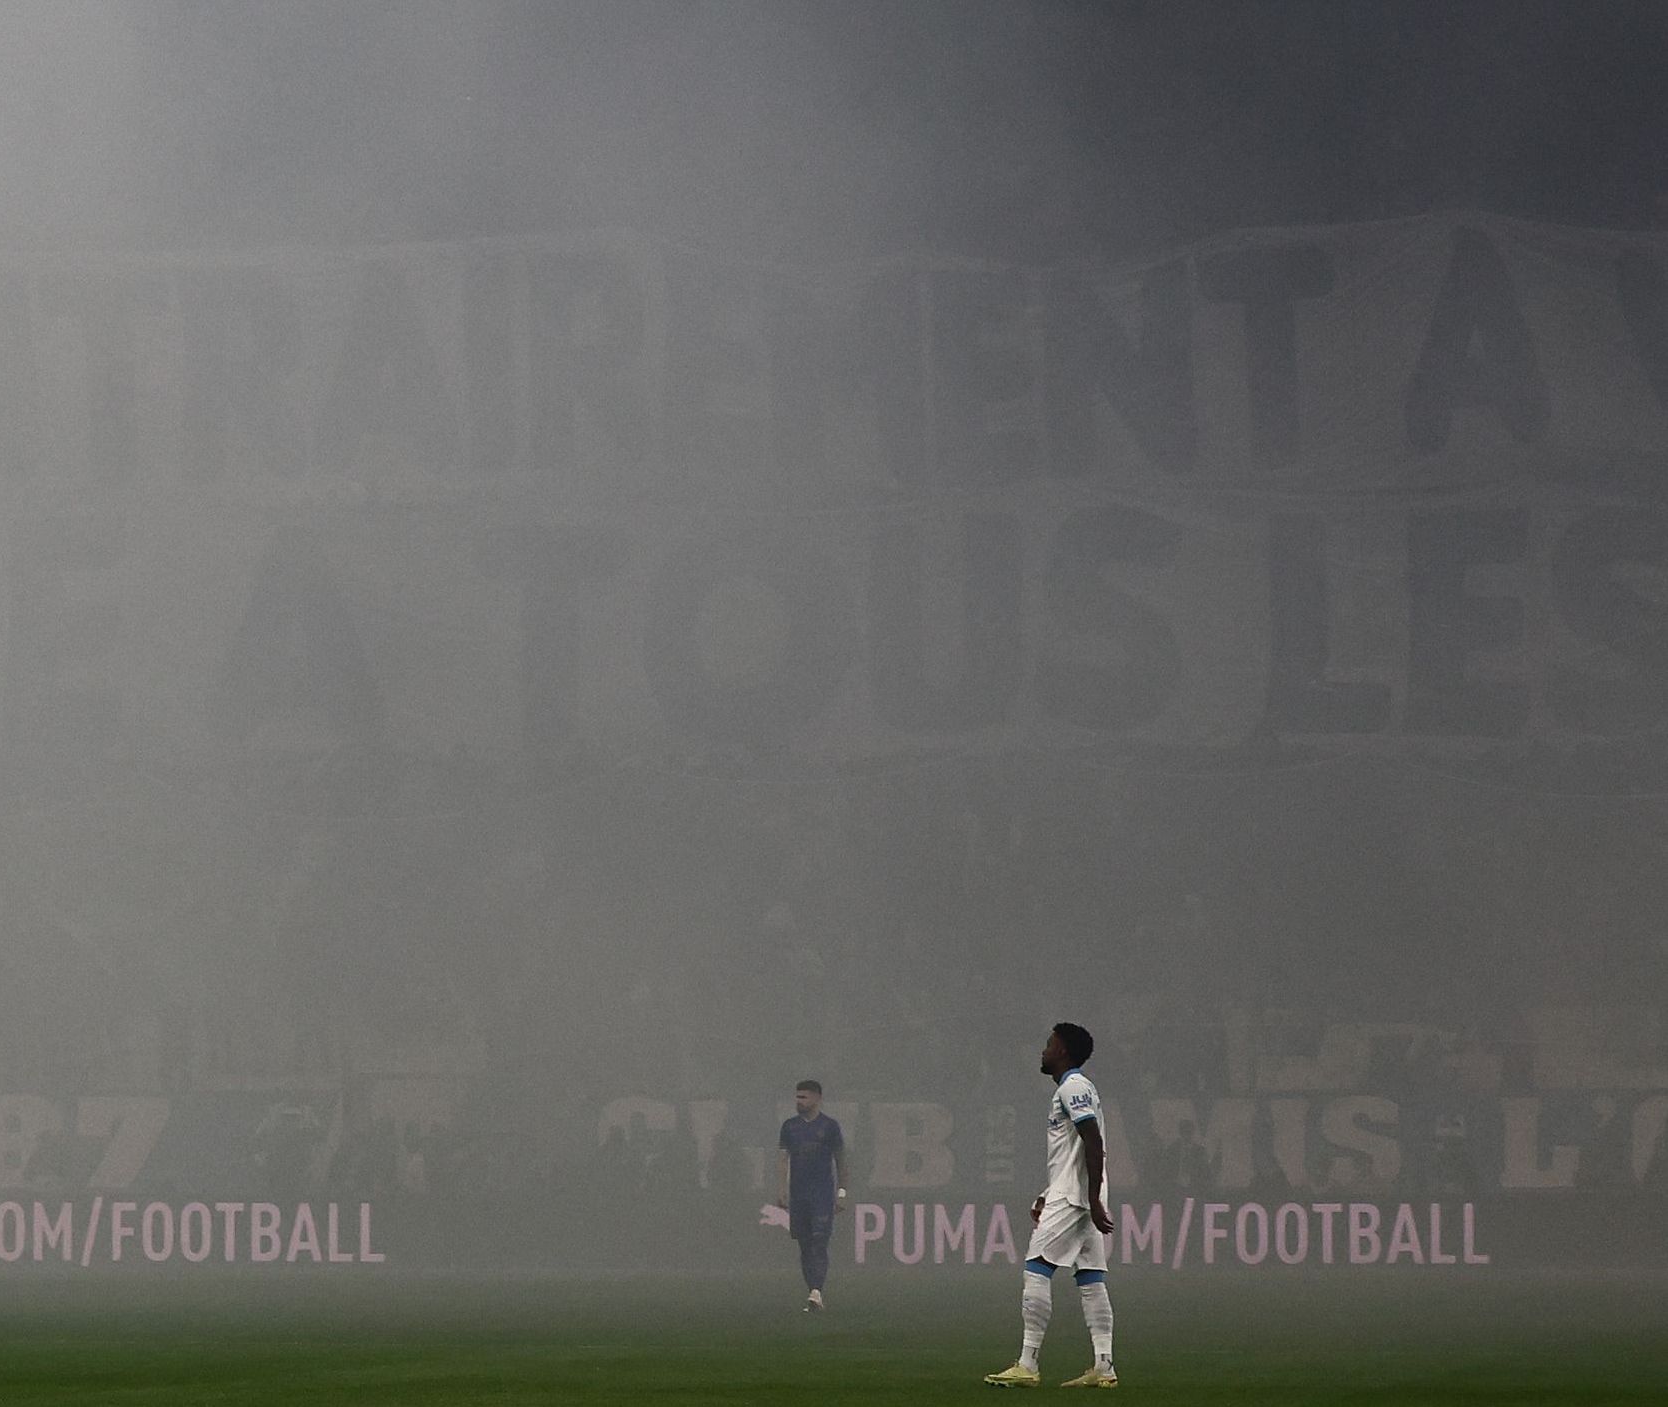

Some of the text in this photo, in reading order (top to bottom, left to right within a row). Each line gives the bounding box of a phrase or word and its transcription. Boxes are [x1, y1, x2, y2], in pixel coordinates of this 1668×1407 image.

[208, 520, 385, 750] A
[471, 500, 1187, 752] TOUS
[1265, 500, 1668, 740] LES
[855, 1196, 1490, 1269] PUMAM/FOOTBALL
